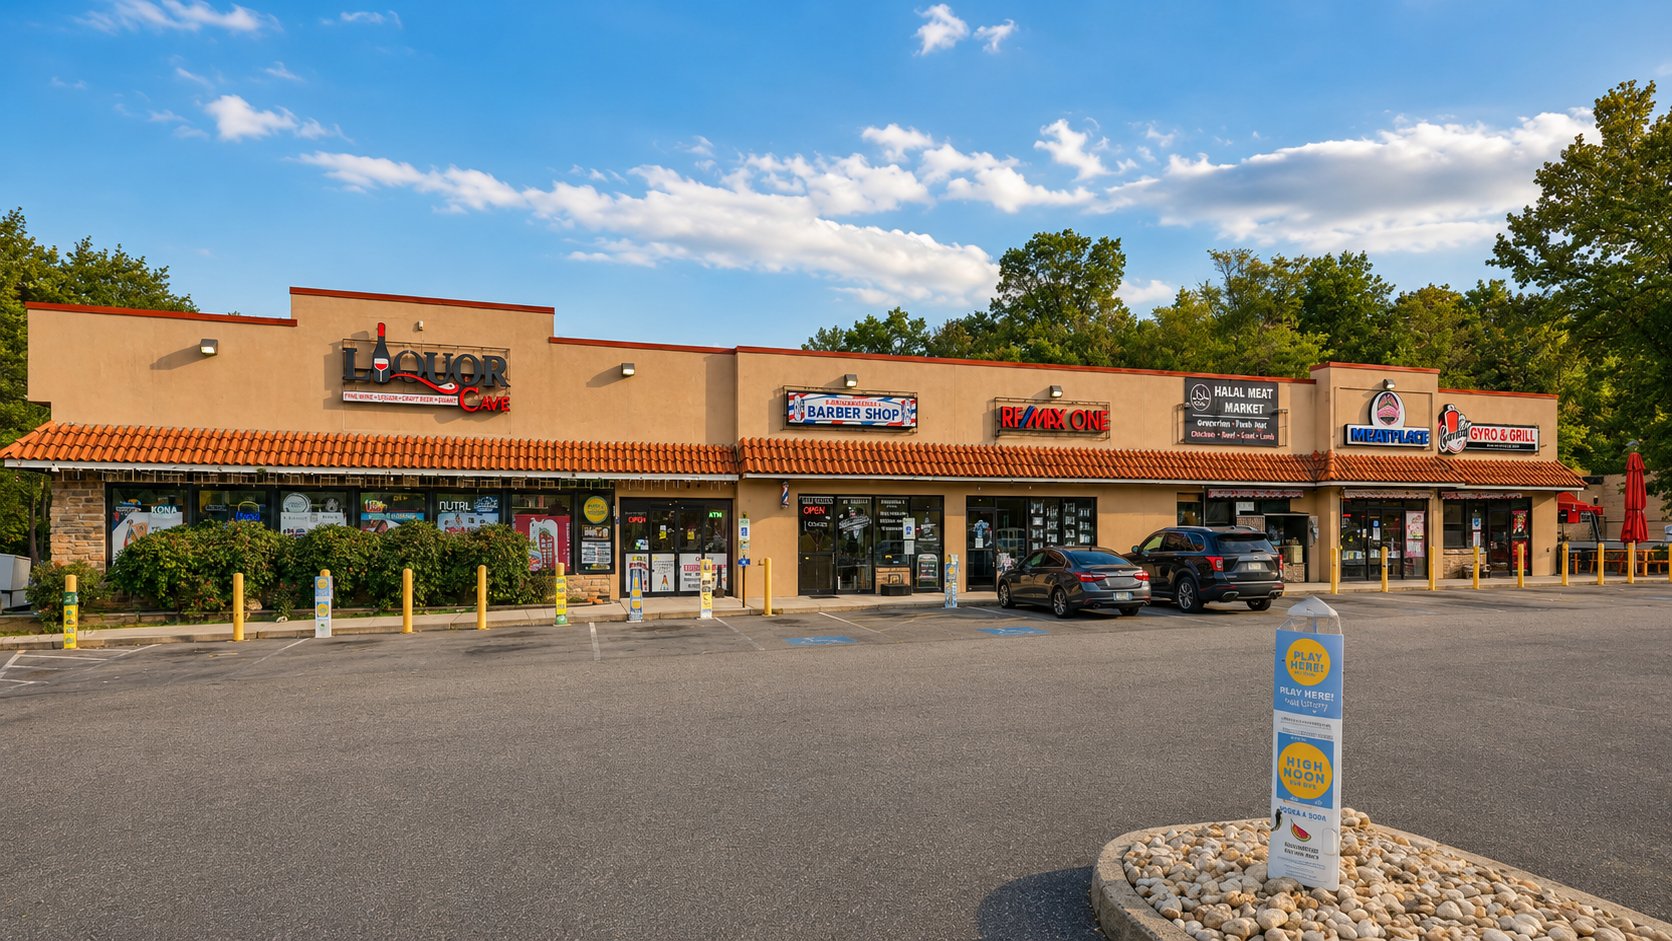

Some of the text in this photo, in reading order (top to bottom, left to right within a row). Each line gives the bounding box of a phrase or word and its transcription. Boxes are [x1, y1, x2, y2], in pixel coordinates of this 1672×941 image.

[342, 334, 511, 388] LIQUOR
[1214, 385, 1245, 398] HALAL
[1247, 387, 1274, 399] MEAT
[459, 387, 511, 412] CAVE
[807, 405, 900, 421] BARBER SHOP
[1224, 402, 1265, 414] MARKET
[1070, 409, 1111, 431] ONE
[1470, 427, 1498, 441] GYRO
[1500, 428, 1508, 441] &
[1509, 429, 1535, 442] GRILL
[151, 505, 177, 514] KONA
[803, 506, 826, 515] OPEN
[1293, 650, 1323, 662] PLAY
[1290, 660, 1325, 673] HERE!
[1304, 689, 1334, 702] HERE!
[1286, 756, 1323, 772] HIGH
[1283, 767, 1325, 784] NOON
